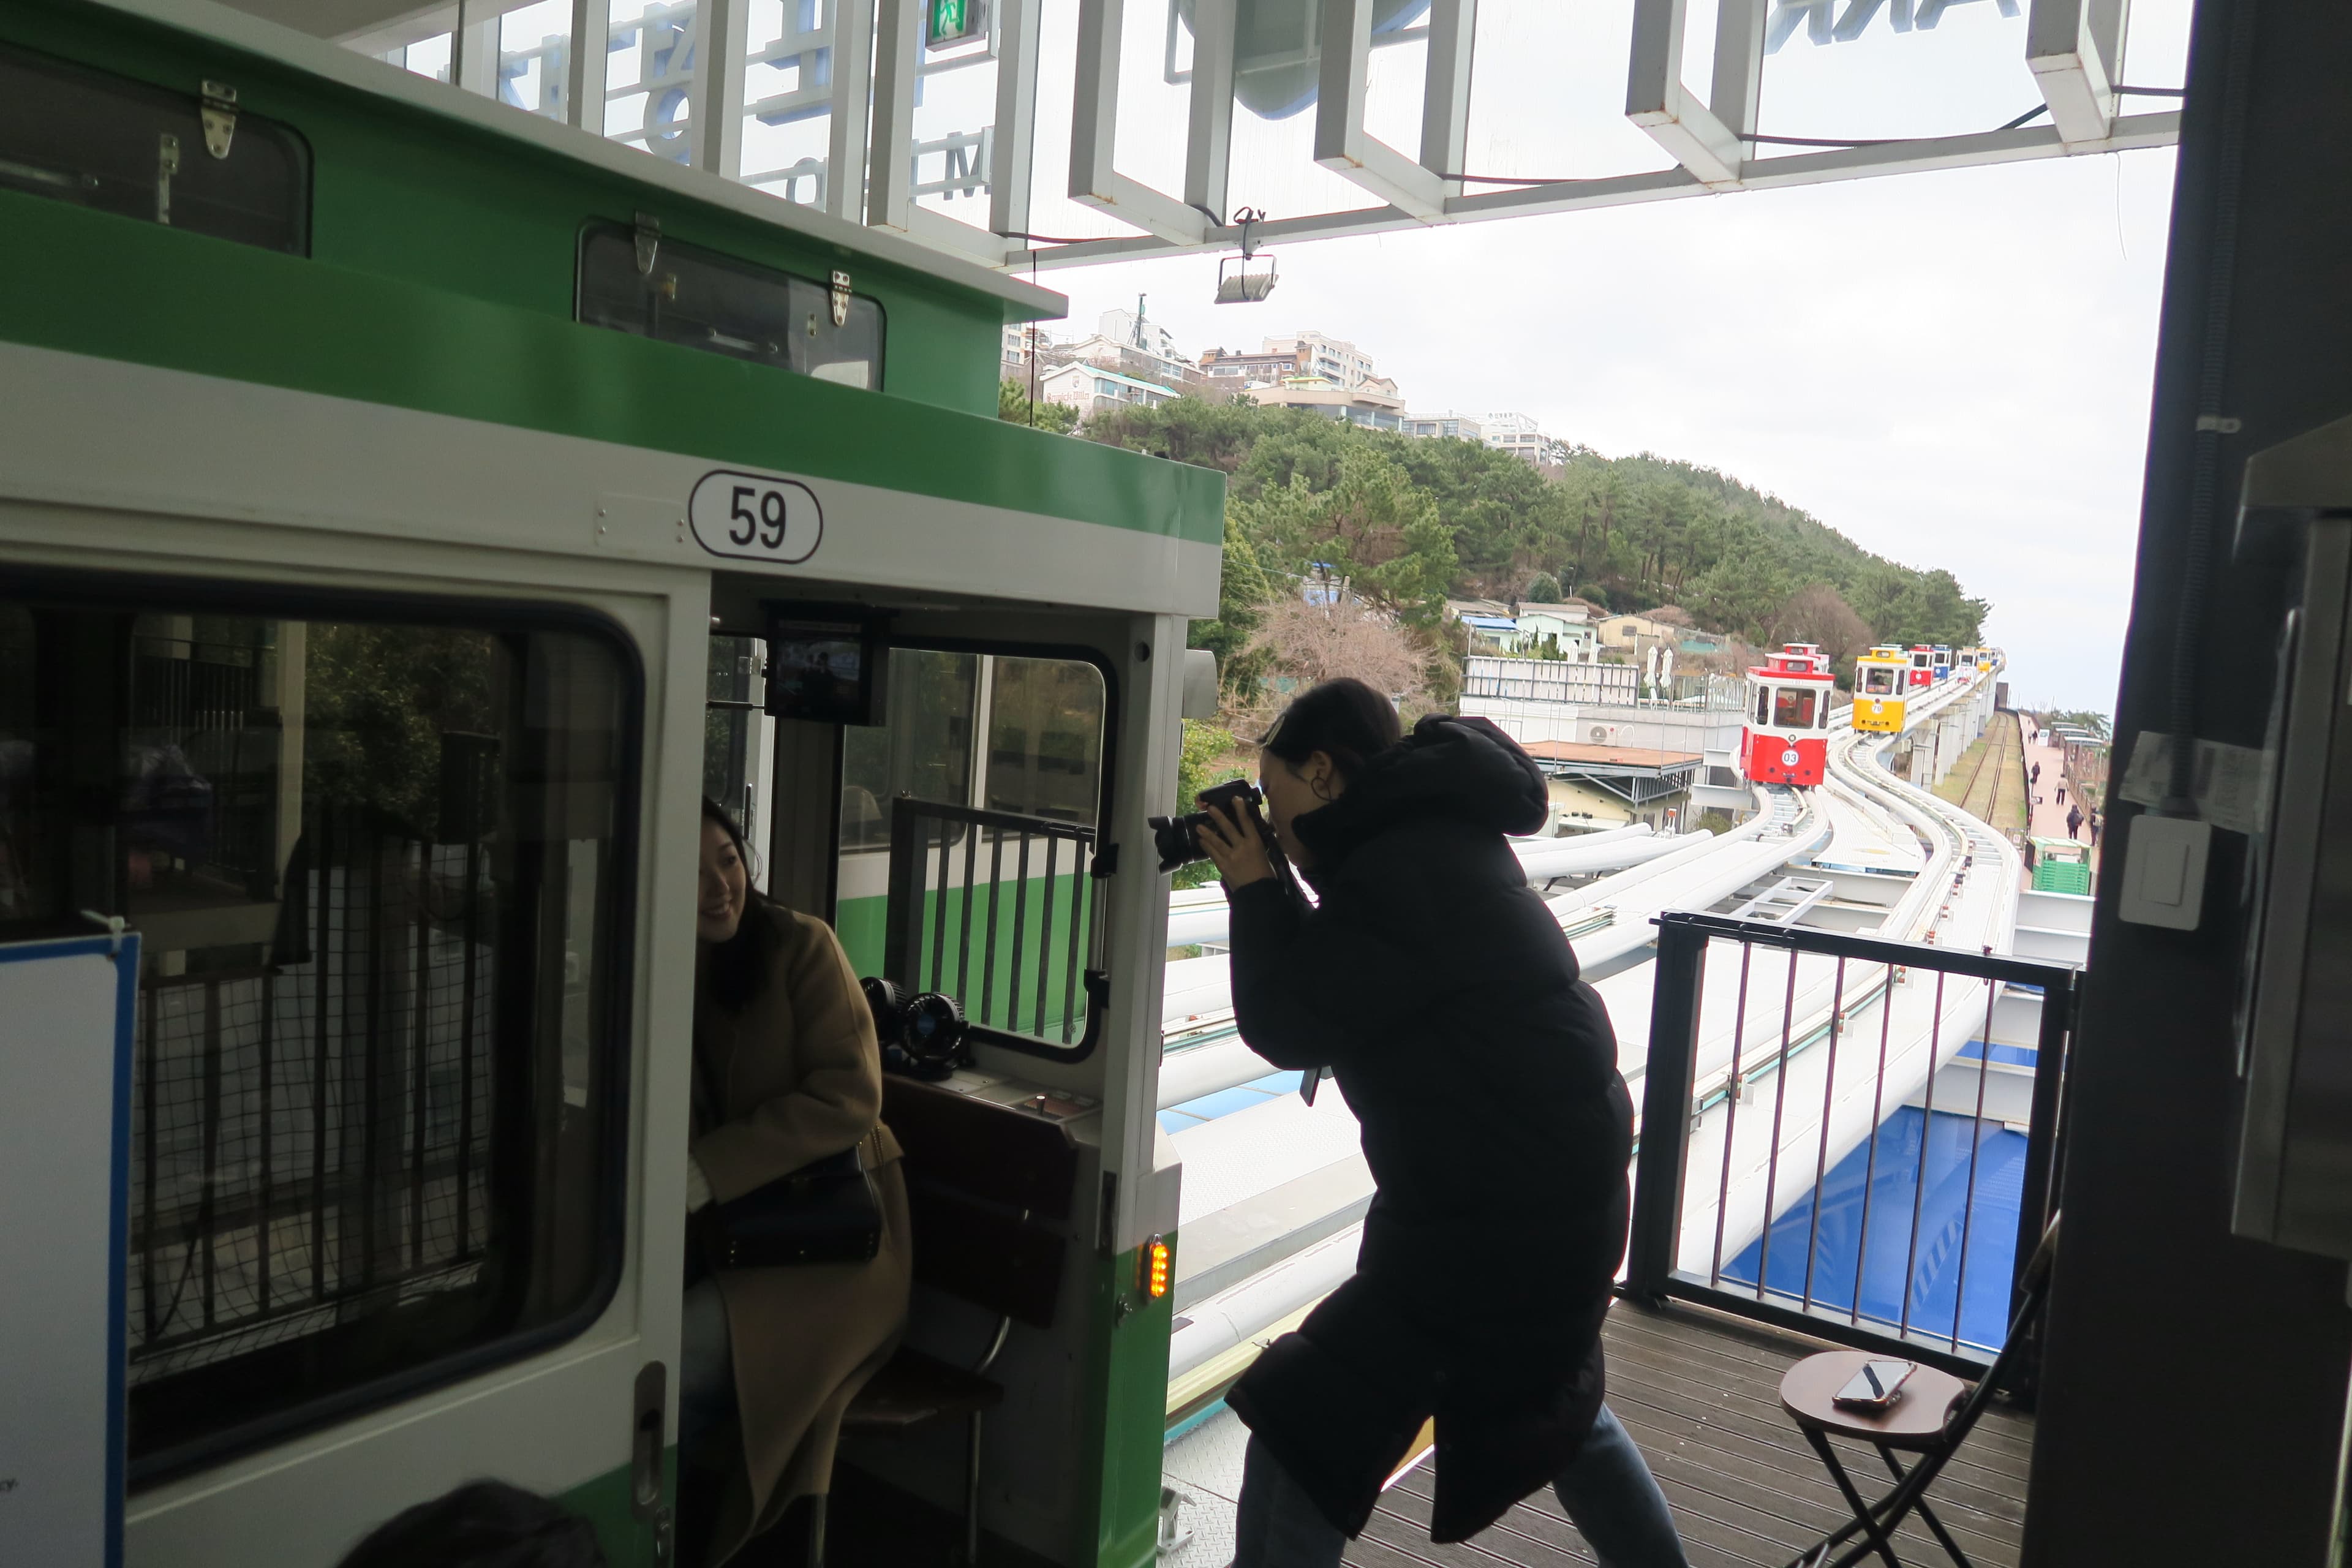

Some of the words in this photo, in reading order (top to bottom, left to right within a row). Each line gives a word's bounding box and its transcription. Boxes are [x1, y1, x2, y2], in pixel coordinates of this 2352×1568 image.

[1072, 390, 1090, 400] Villa
[729, 485, 786, 549] 59
[1784, 753, 1797, 763] 03
